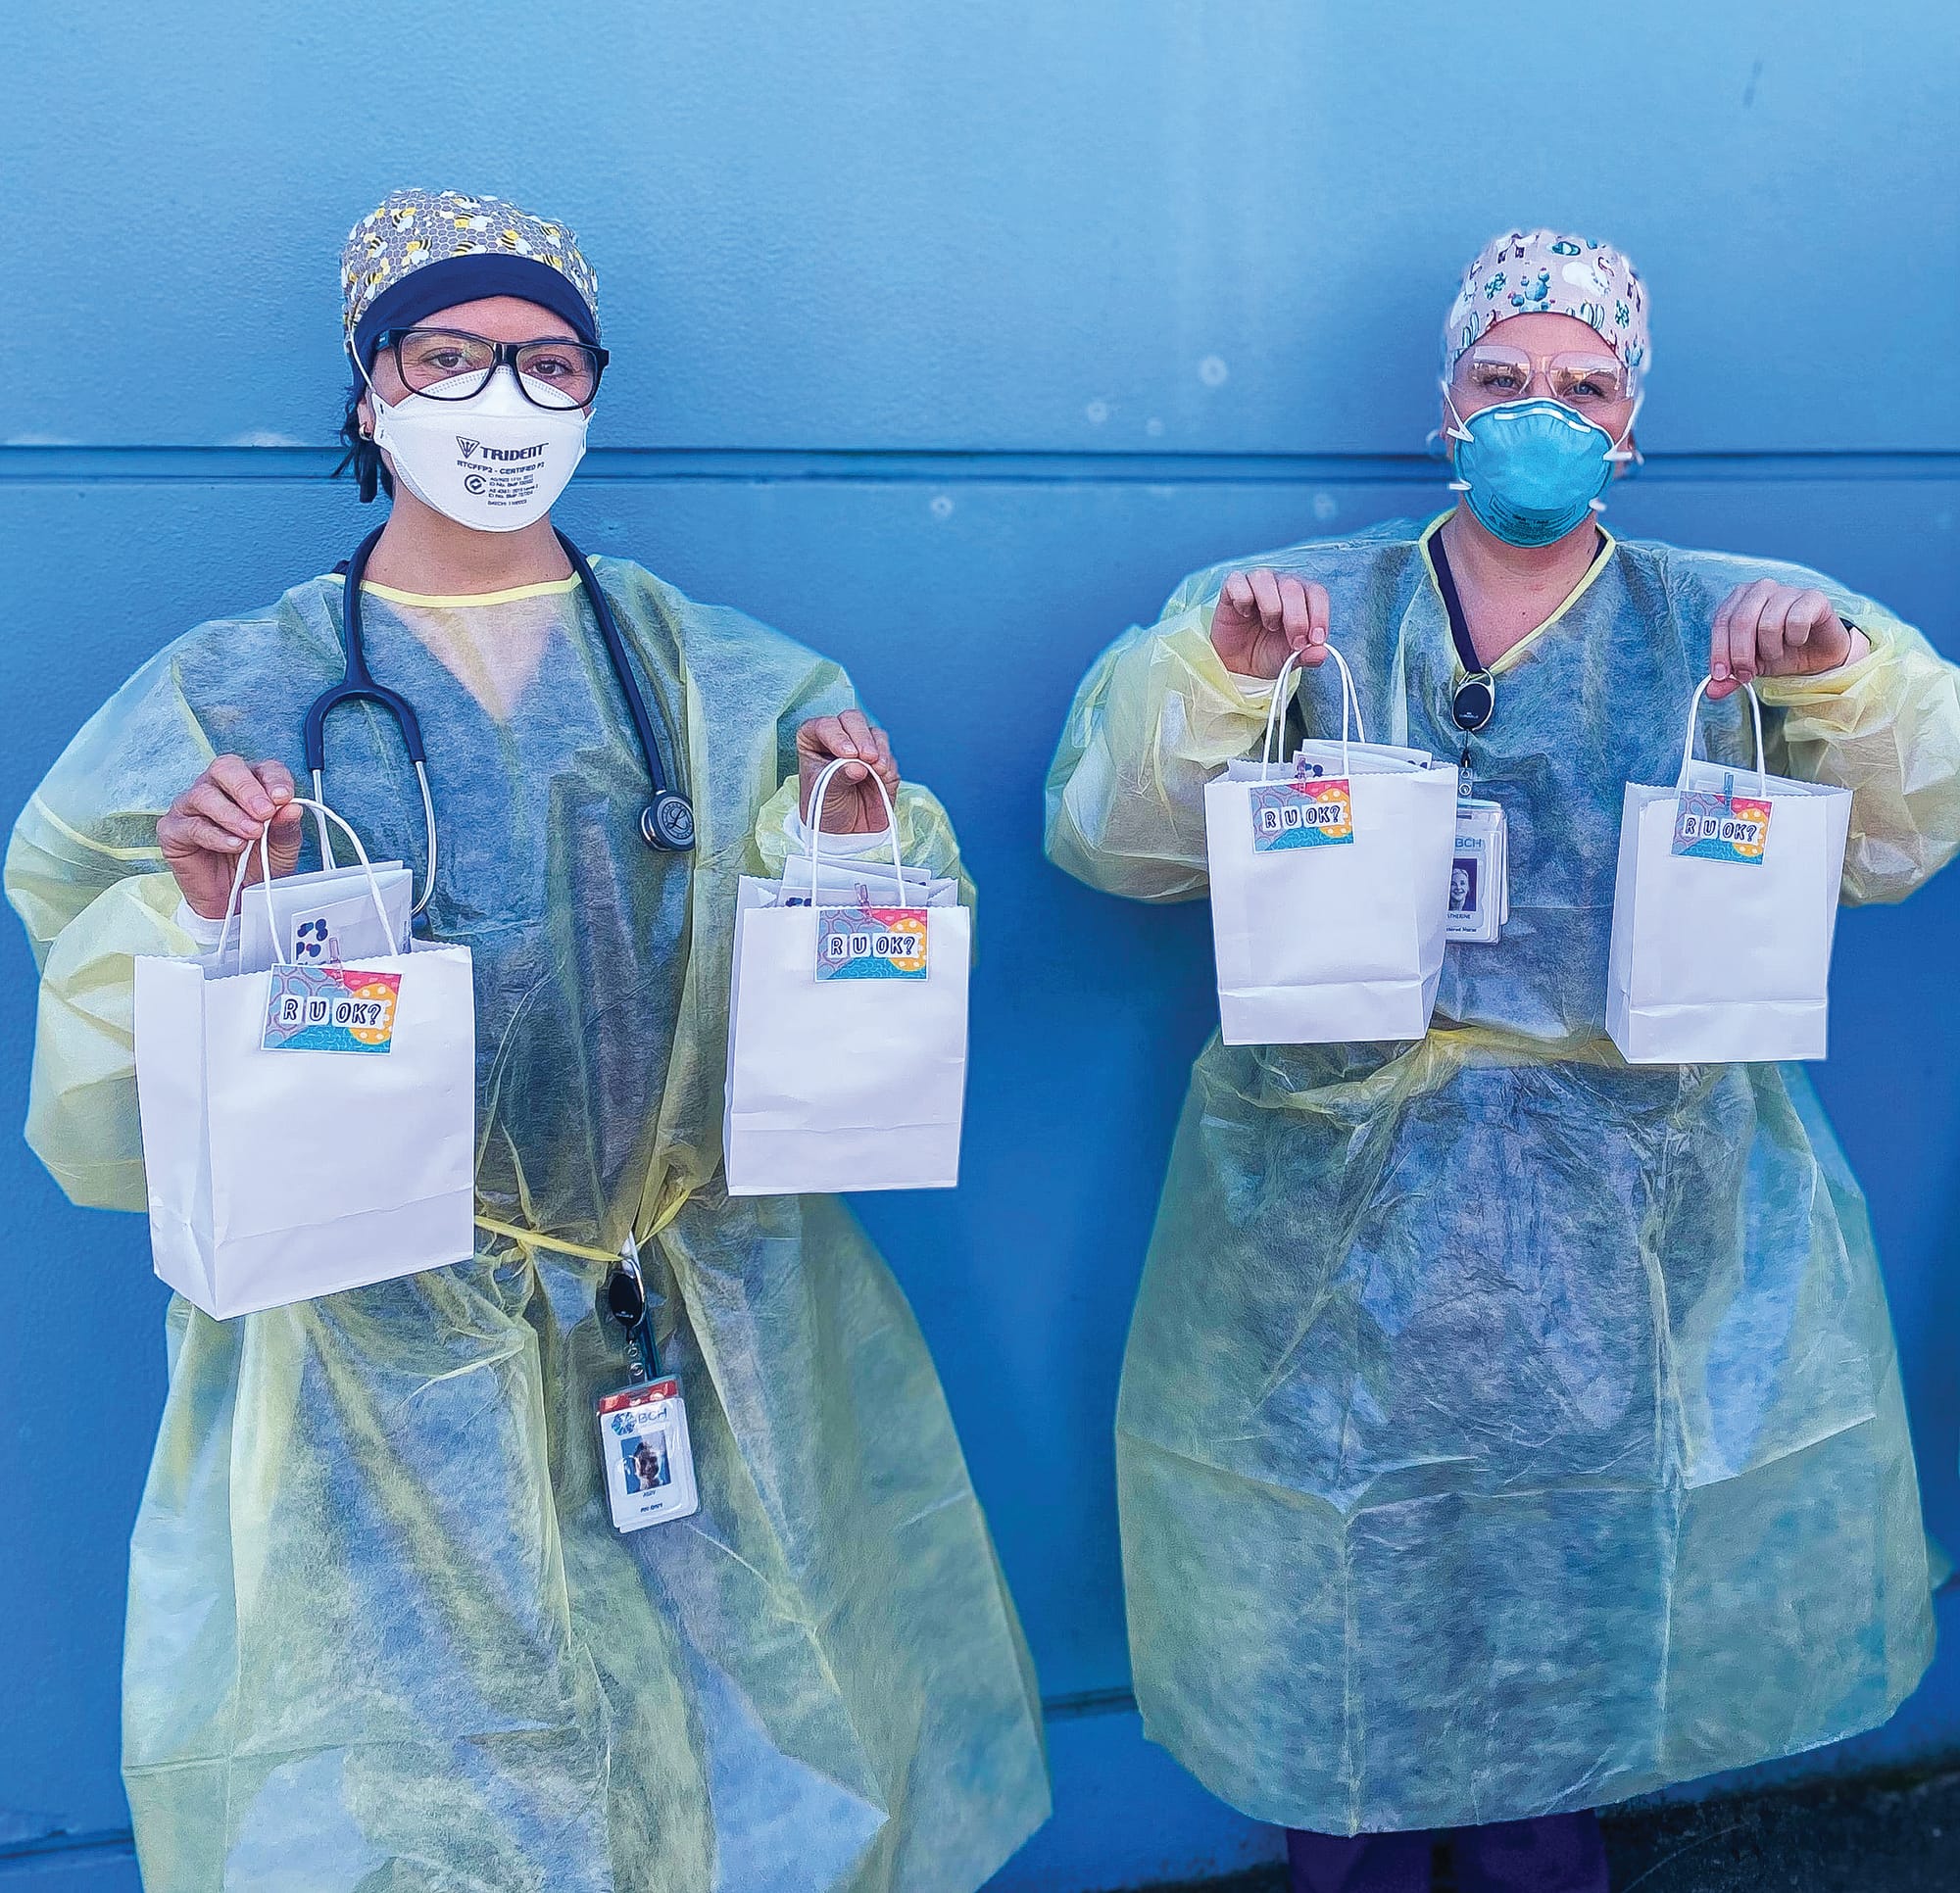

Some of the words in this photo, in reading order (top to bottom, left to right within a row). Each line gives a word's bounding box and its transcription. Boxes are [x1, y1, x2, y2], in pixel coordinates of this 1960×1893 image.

[480, 443, 549, 461] TRIDENT
[499, 463, 536, 475] CERTIFIED
[1265, 810, 1276, 829] R
[1285, 809, 1298, 826] U
[1305, 805, 1341, 825] OK?
[1685, 817, 1696, 834] R
[1703, 820, 1716, 836] U
[1722, 822, 1757, 842] OK?
[1454, 838, 1482, 848] BCH
[831, 937, 843, 955] R
[853, 936, 867, 954] U
[876, 936, 915, 955] OK?
[283, 998, 299, 1020] R
[310, 1000, 326, 1022] U
[335, 1002, 381, 1026] OK?
[638, 1407, 667, 1424] BCH
